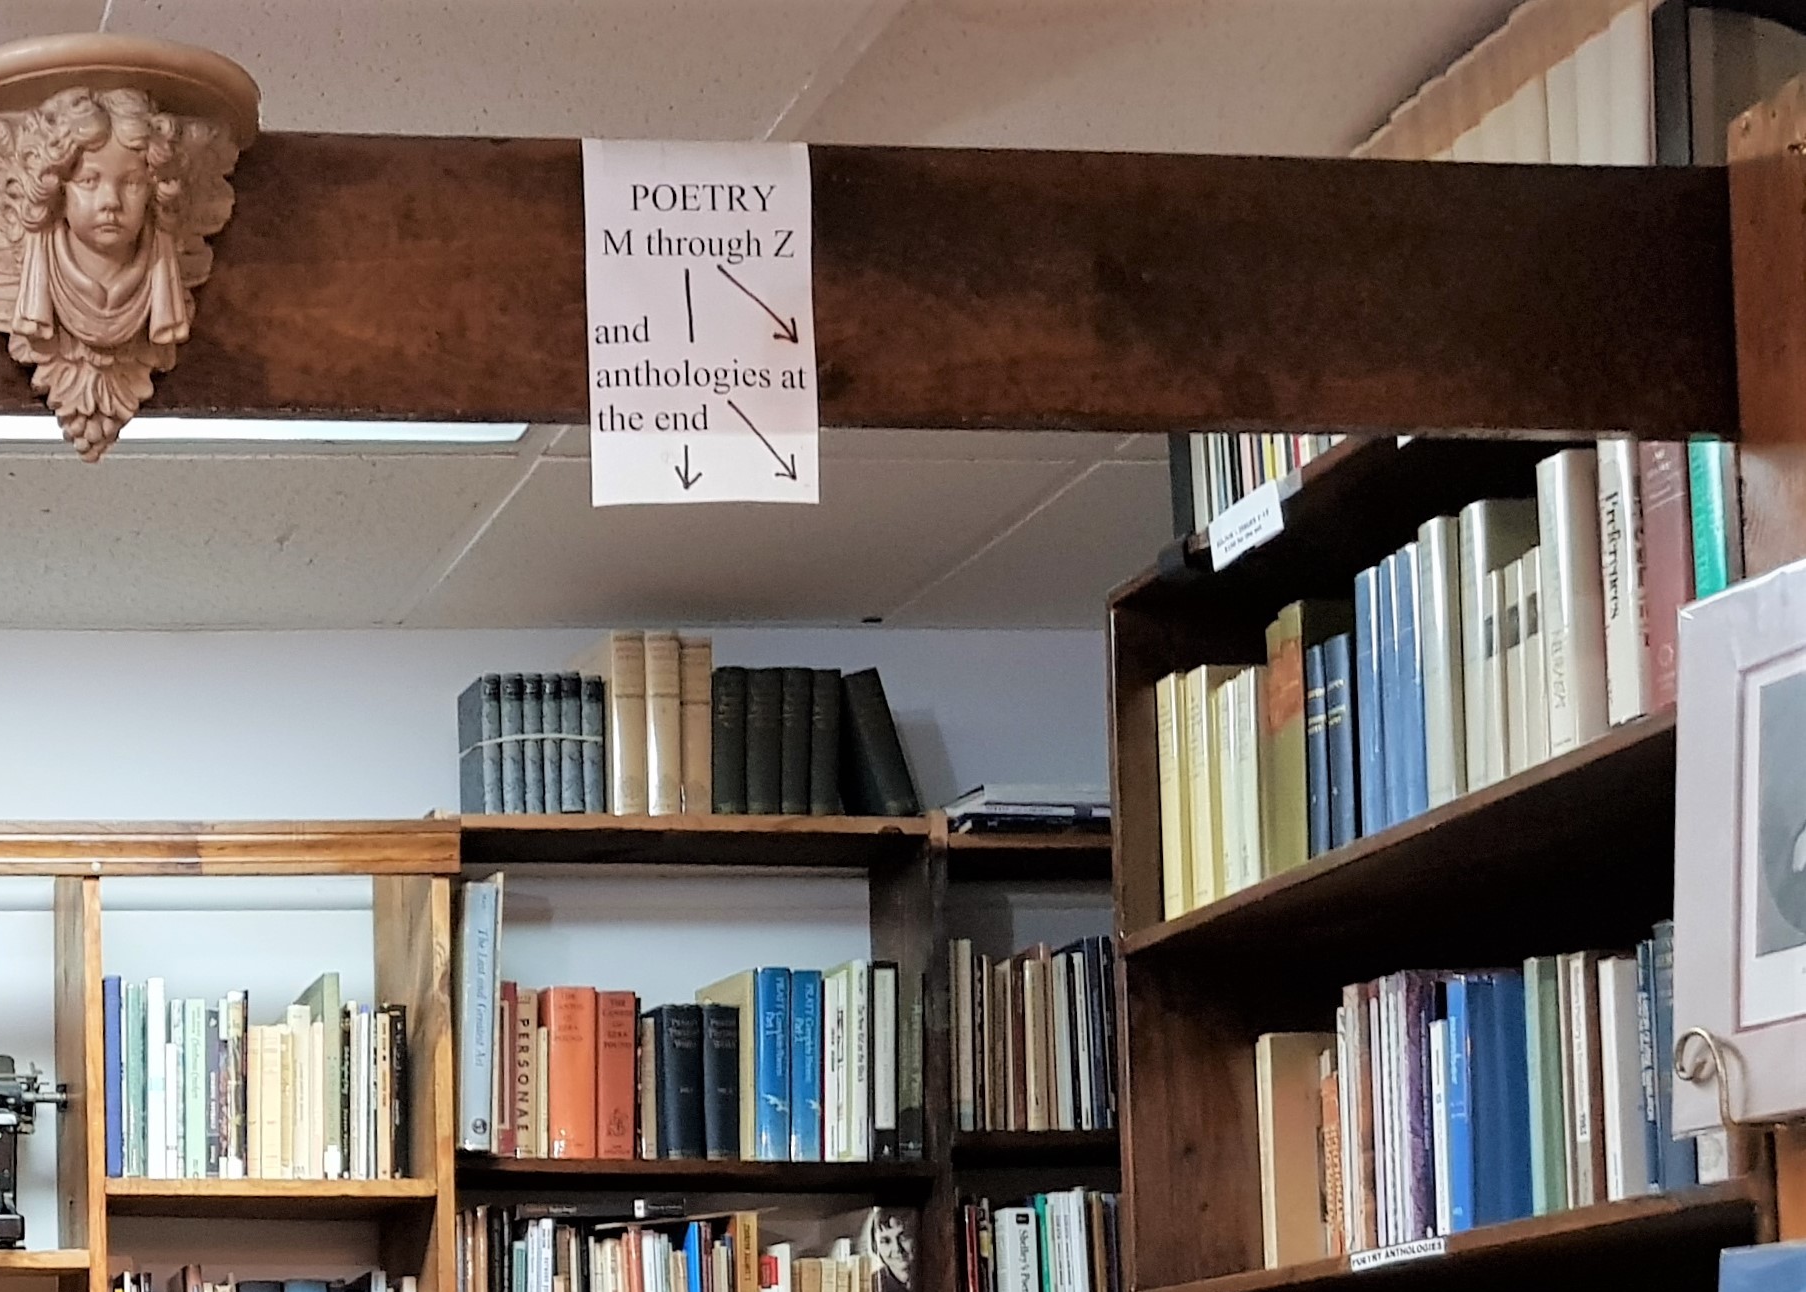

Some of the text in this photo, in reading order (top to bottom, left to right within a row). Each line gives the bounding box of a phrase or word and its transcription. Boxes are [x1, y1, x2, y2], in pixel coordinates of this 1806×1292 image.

[630, 184, 777, 213] POETRY
[603, 228, 795, 264] M through Z
[595, 316, 651, 345] and
[596, 359, 807, 395] anthologies at
[598, 404, 709, 432] the end
[516, 1018, 530, 1133] PERSONAE
